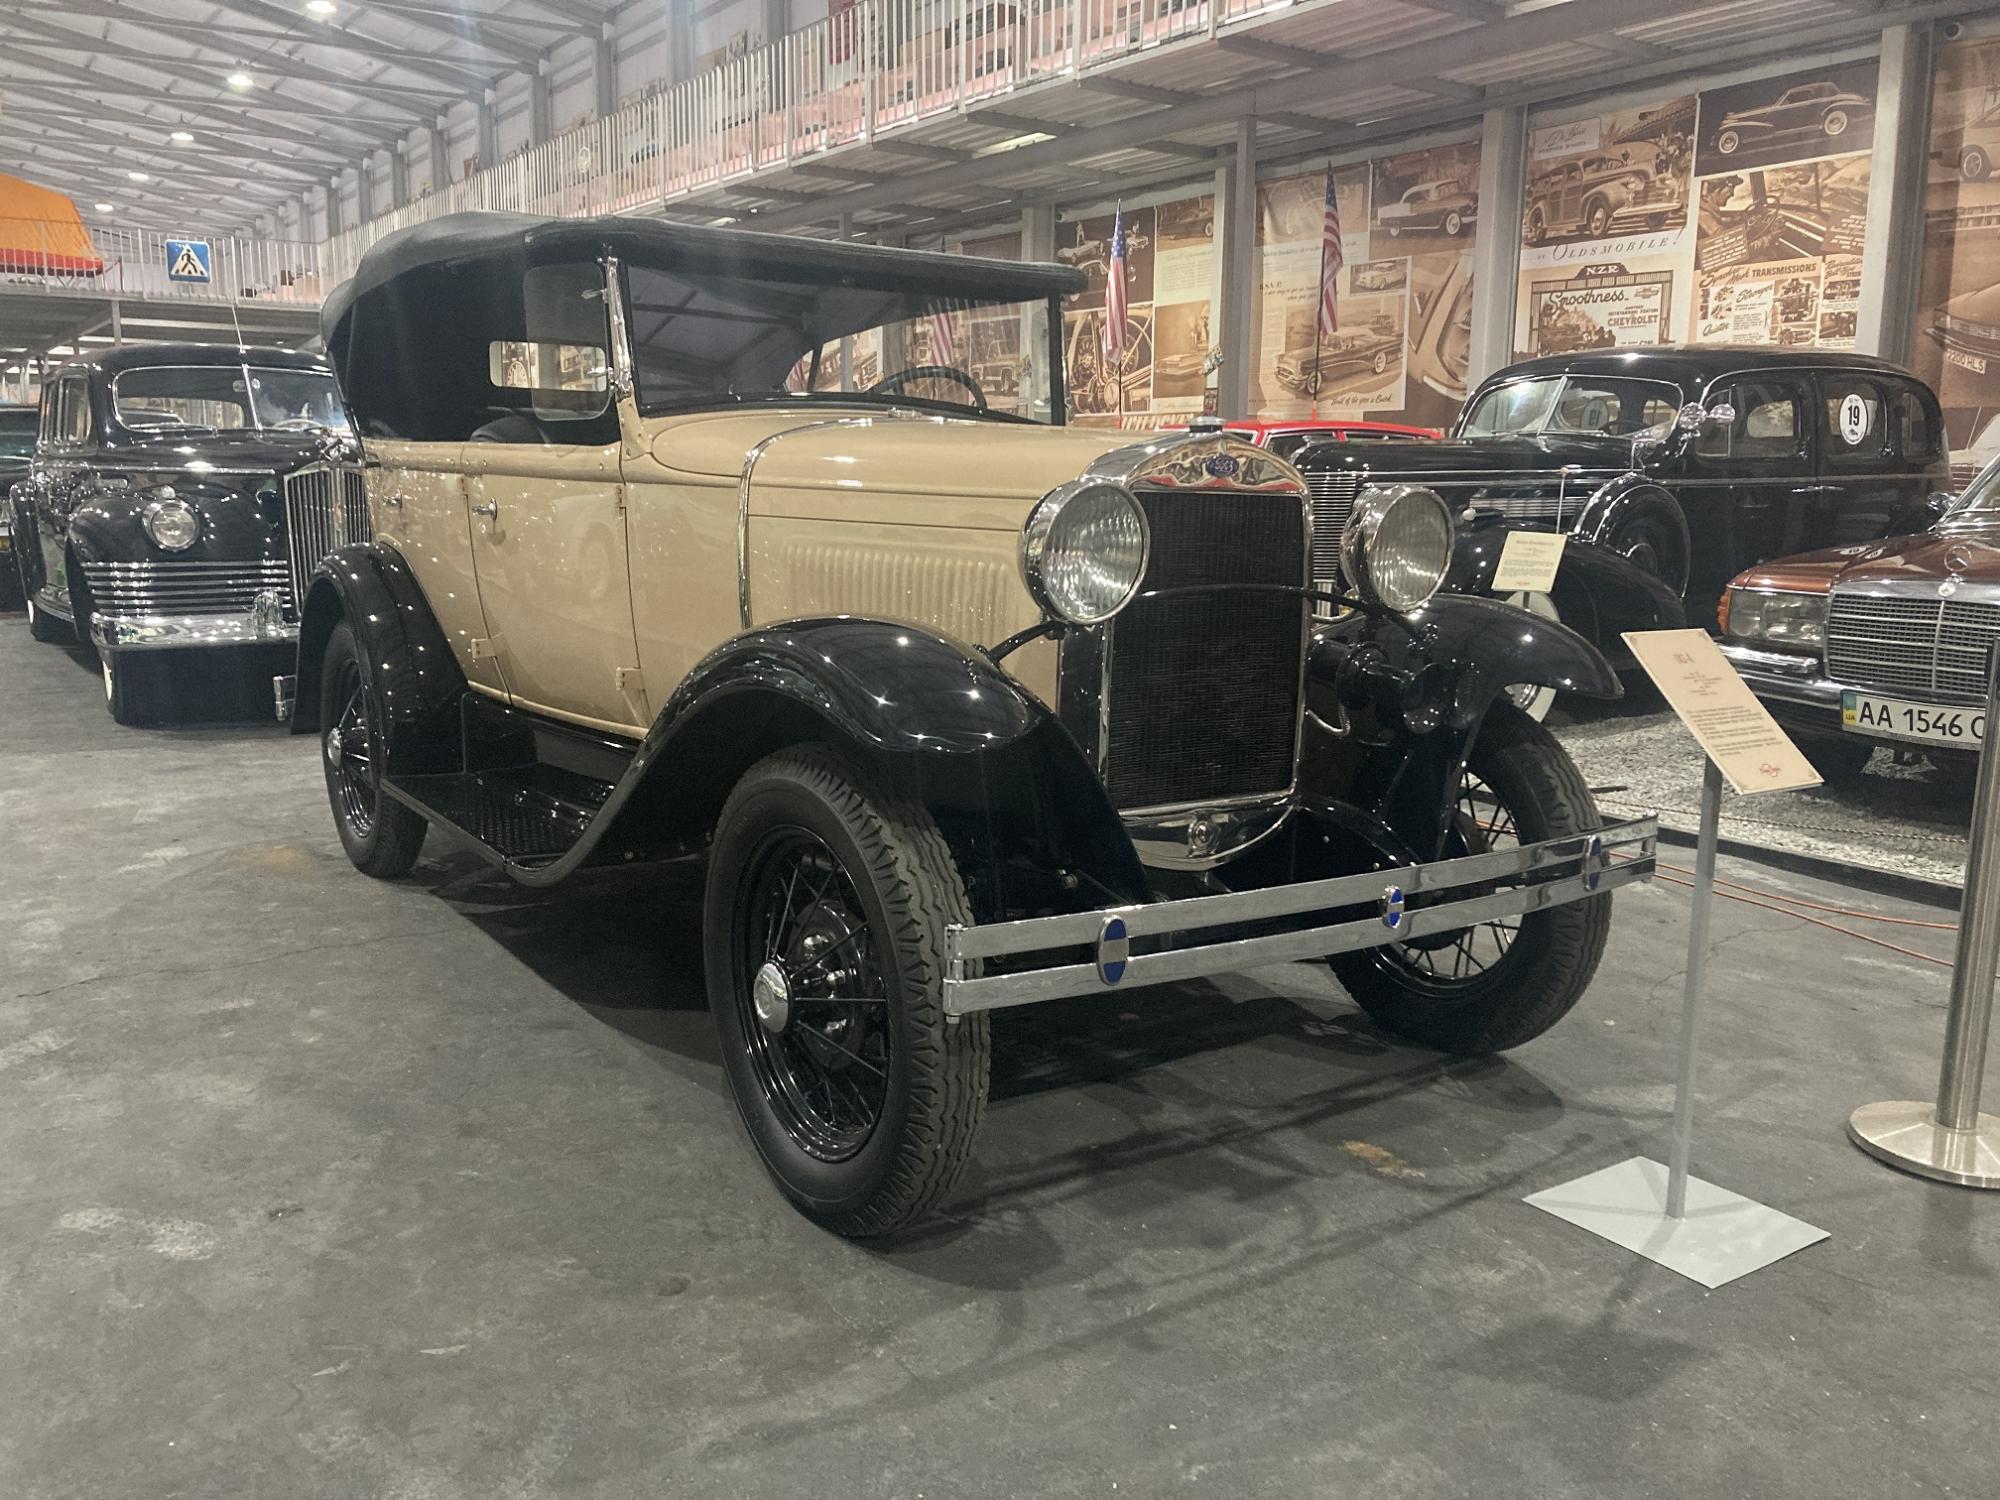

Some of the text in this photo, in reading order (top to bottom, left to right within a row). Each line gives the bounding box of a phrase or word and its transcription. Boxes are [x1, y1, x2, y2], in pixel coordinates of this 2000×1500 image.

[1586, 265, 1620, 276] NZR
[1752, 263, 1817, 278] TRANSMISSIONS
[1607, 314, 1659, 327] CHEVROLET
[1848, 405, 1860, 426] 19
[1859, 702, 1893, 728] AA
[1903, 709, 1963, 737] 1546
